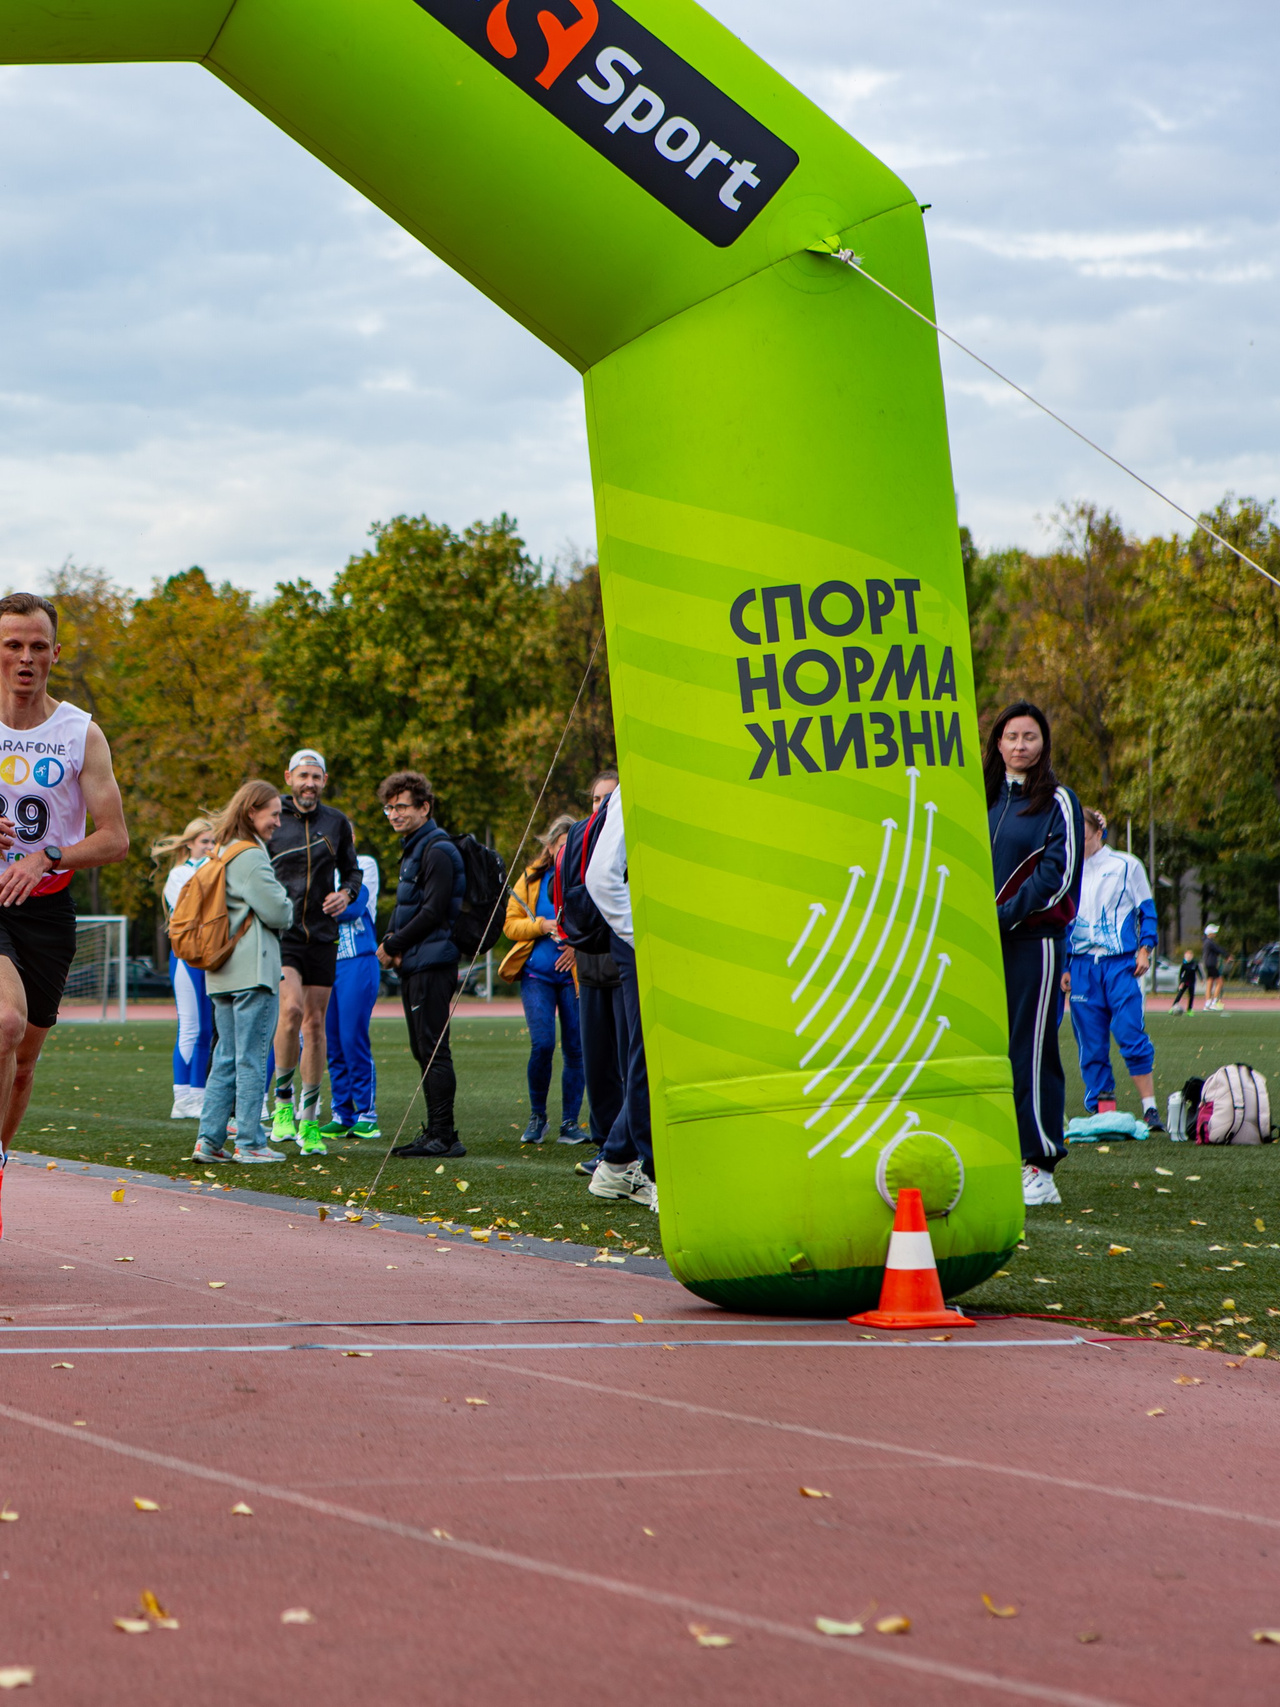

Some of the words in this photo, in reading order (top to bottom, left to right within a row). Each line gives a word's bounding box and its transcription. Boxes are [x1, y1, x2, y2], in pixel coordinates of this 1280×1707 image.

[576, 46, 761, 212] Sport
[729, 578, 921, 645] СПОРТ
[736, 644, 958, 713] НОРМА
[744, 710, 965, 780] ЖИЗНИ
